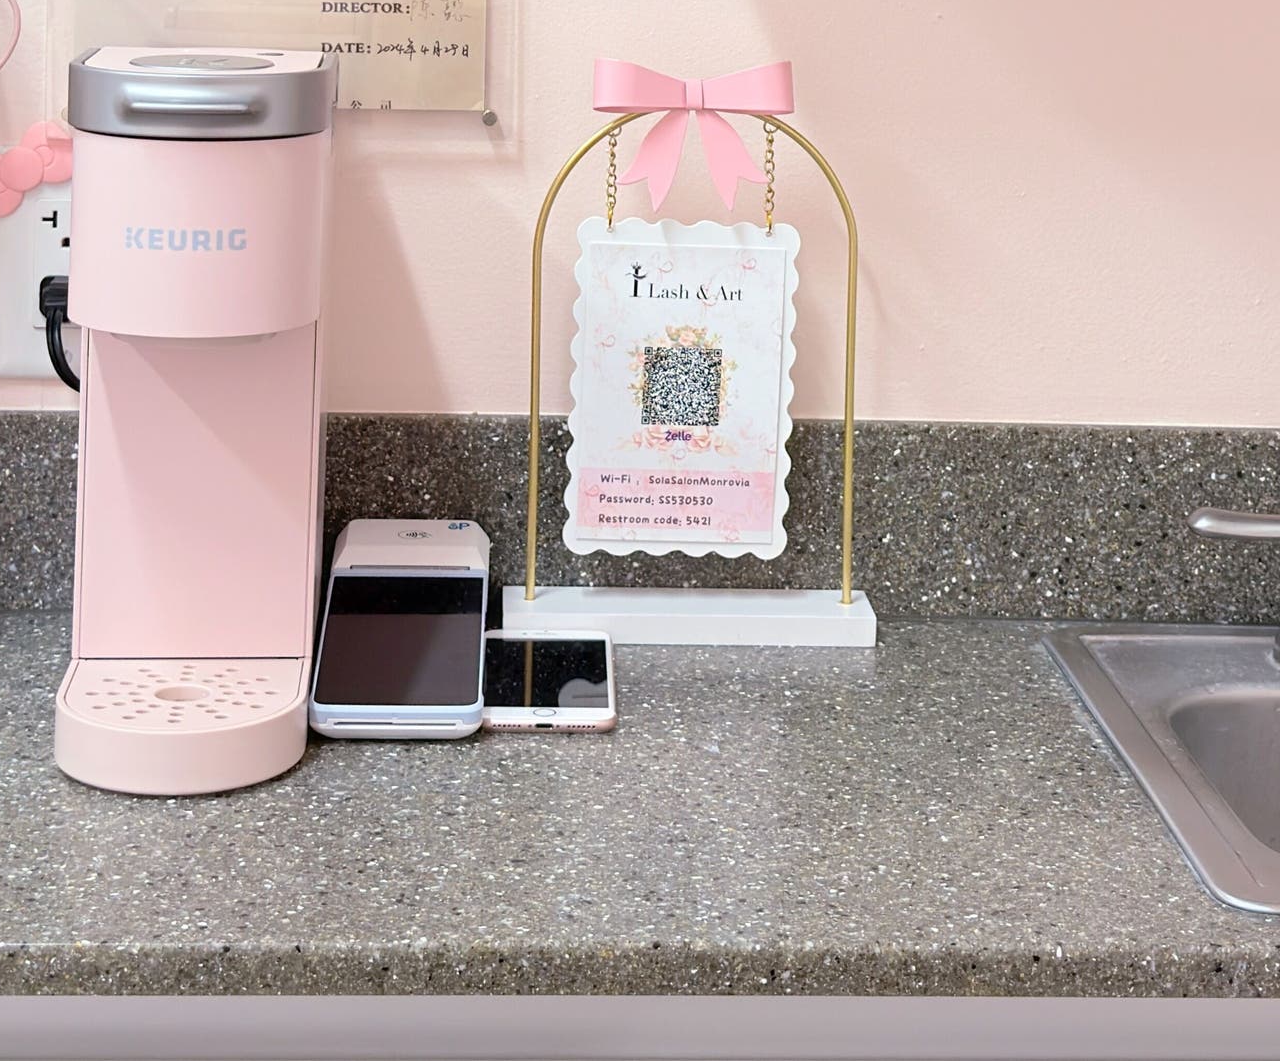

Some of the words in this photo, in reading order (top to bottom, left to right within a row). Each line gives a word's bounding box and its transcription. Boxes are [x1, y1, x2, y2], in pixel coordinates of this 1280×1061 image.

[322, 2, 410, 14] DIRECTOR:
[322, 42, 371, 54] DATE:
[124, 226, 248, 252] KEURIG
[649, 283, 689, 299] Lash
[716, 286, 742, 300] Art
[665, 430, 692, 442] Zelle
[600, 474, 631, 484] Wi-Fi
[648, 476, 750, 487] SolaSalonMonrovia
[599, 494, 654, 506] Password:
[658, 496, 714, 506] SS530530
[598, 514, 650, 524] Restroom
[654, 516, 682, 526] code:
[686, 516, 711, 526] 5421
